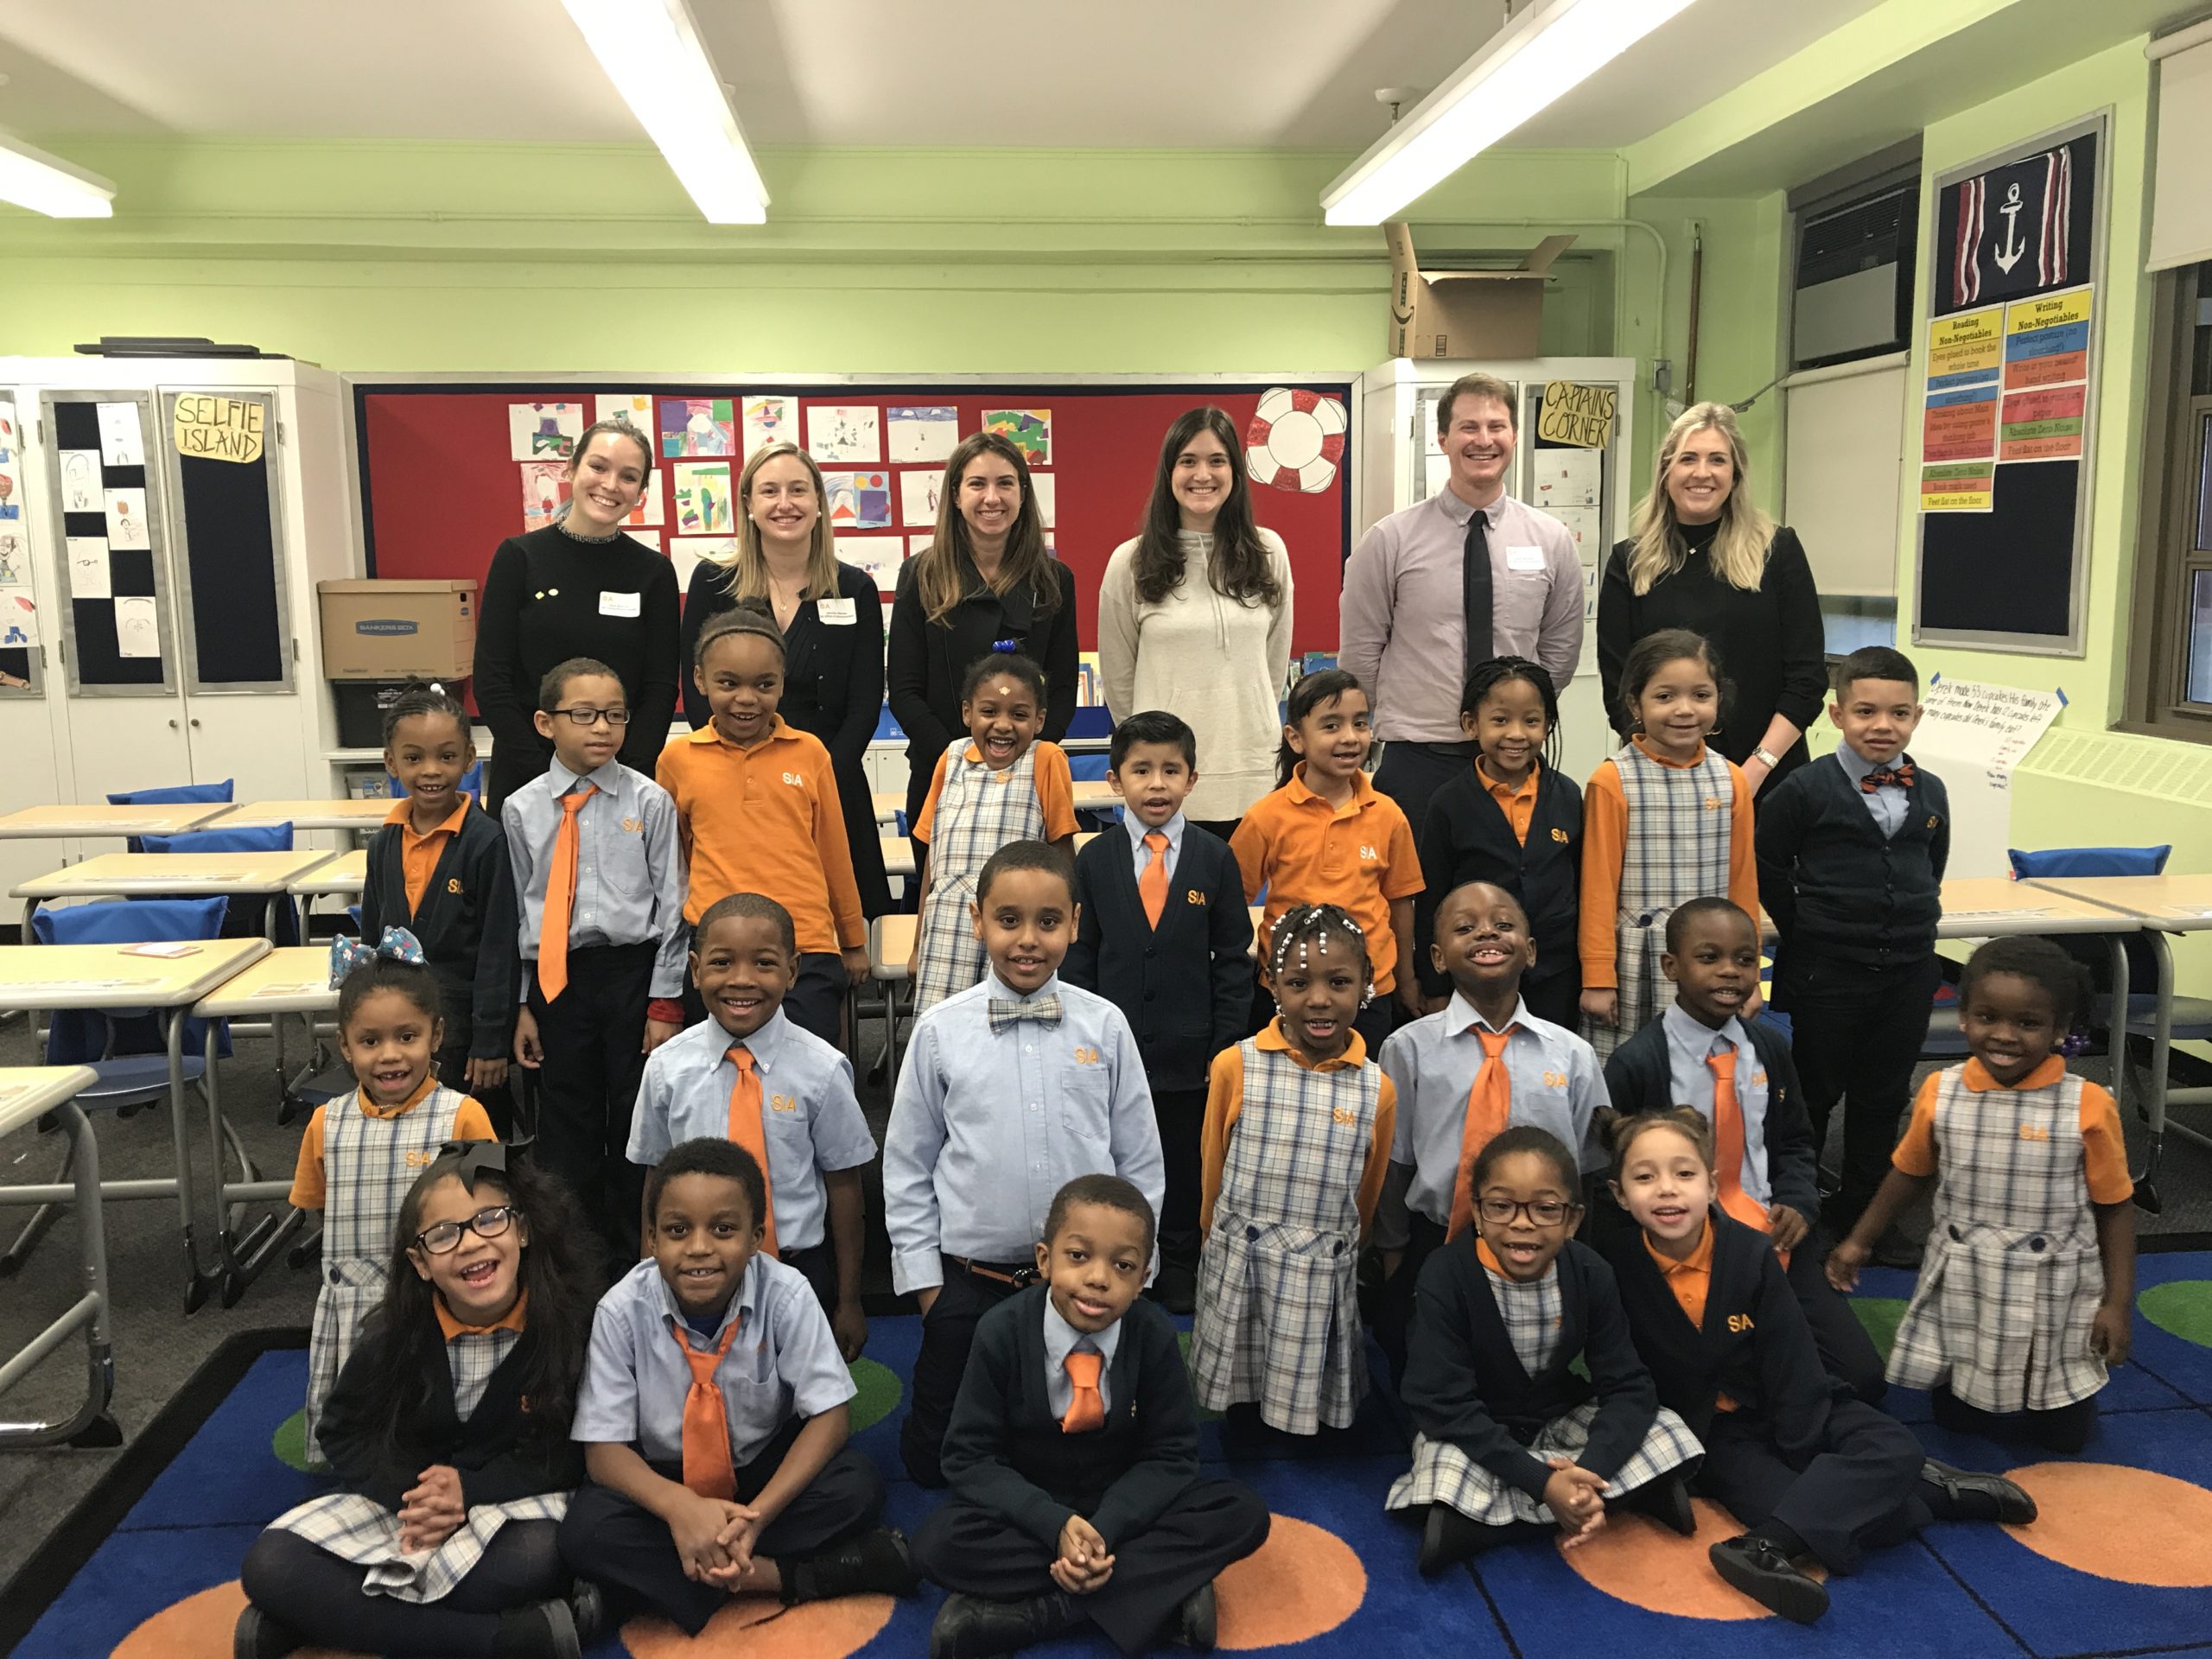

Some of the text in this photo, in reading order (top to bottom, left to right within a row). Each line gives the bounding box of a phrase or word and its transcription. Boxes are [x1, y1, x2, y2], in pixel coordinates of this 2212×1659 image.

[2035, 301, 2063, 313] Writing
[1953, 318, 1979, 330] Reading
[2018, 312, 2079, 330] Non-Negotiables
[1939, 329, 1992, 346] Non-Negotiables
[1932, 353, 1945, 363] Eyes
[1947, 348, 1963, 361] glued
[1971, 345, 1986, 355] book
[1546, 381, 1617, 420] CAPTAINS
[175, 397, 263, 433] SELFIE
[1543, 412, 1606, 448] CORNER
[2037, 424, 2053, 435] Zero
[181, 428, 257, 461] ISLAND
[2007, 445, 2022, 454] Feet
[1928, 497, 1940, 505] Feet
[1958, 496, 1967, 505] the
[1967, 495, 1982, 505] floor
[1931, 681, 1952, 696] Derek
[1955, 683, 1970, 697] made
[2020, 694, 2037, 712] family
